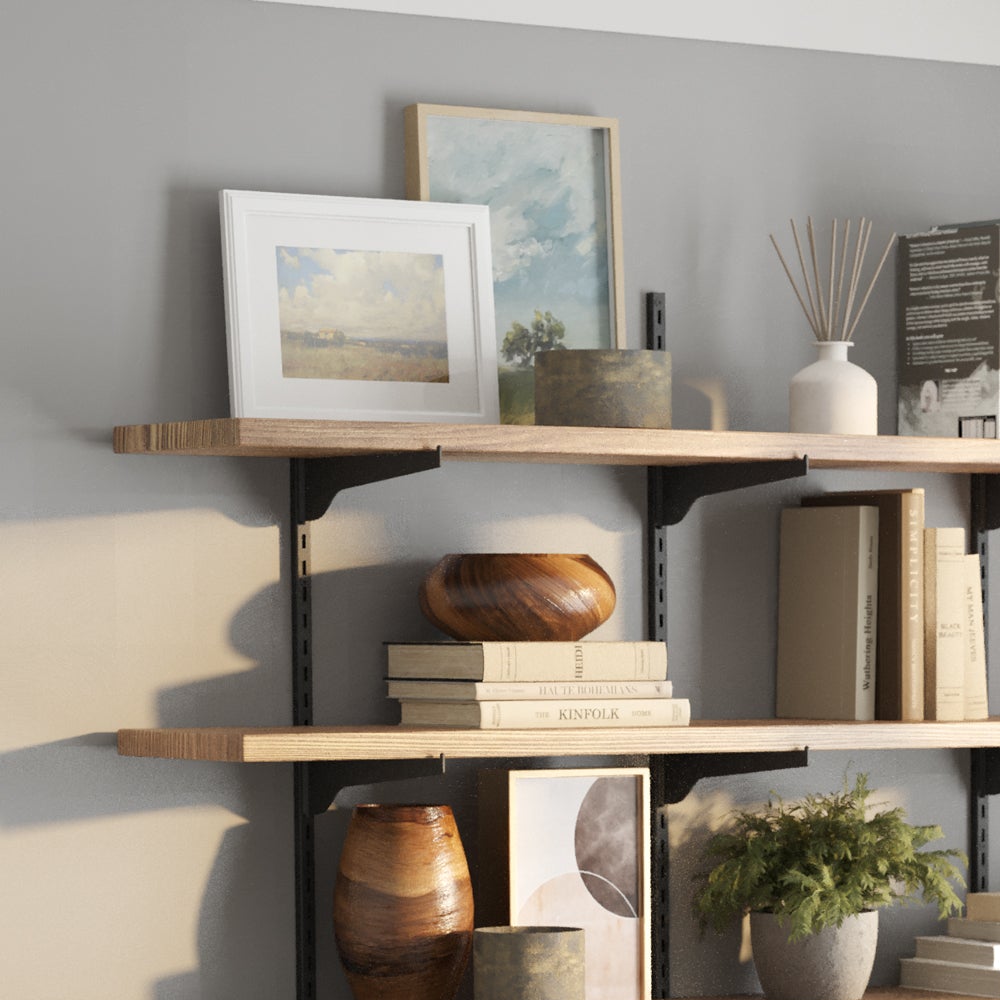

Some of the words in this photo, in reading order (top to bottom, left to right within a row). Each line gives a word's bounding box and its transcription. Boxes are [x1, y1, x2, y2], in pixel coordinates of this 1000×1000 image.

[909, 508, 919, 624] SIMPLICITY
[863, 594, 873, 634] Heights
[967, 604, 975, 626] MAN
[574, 645, 583, 679] HEIDI
[862, 638, 873, 691] Wuthering
[538, 686, 575, 696] HAUTE
[577, 685, 638, 695] BOHEMIANS
[558, 708, 620, 720] KINFOLK
